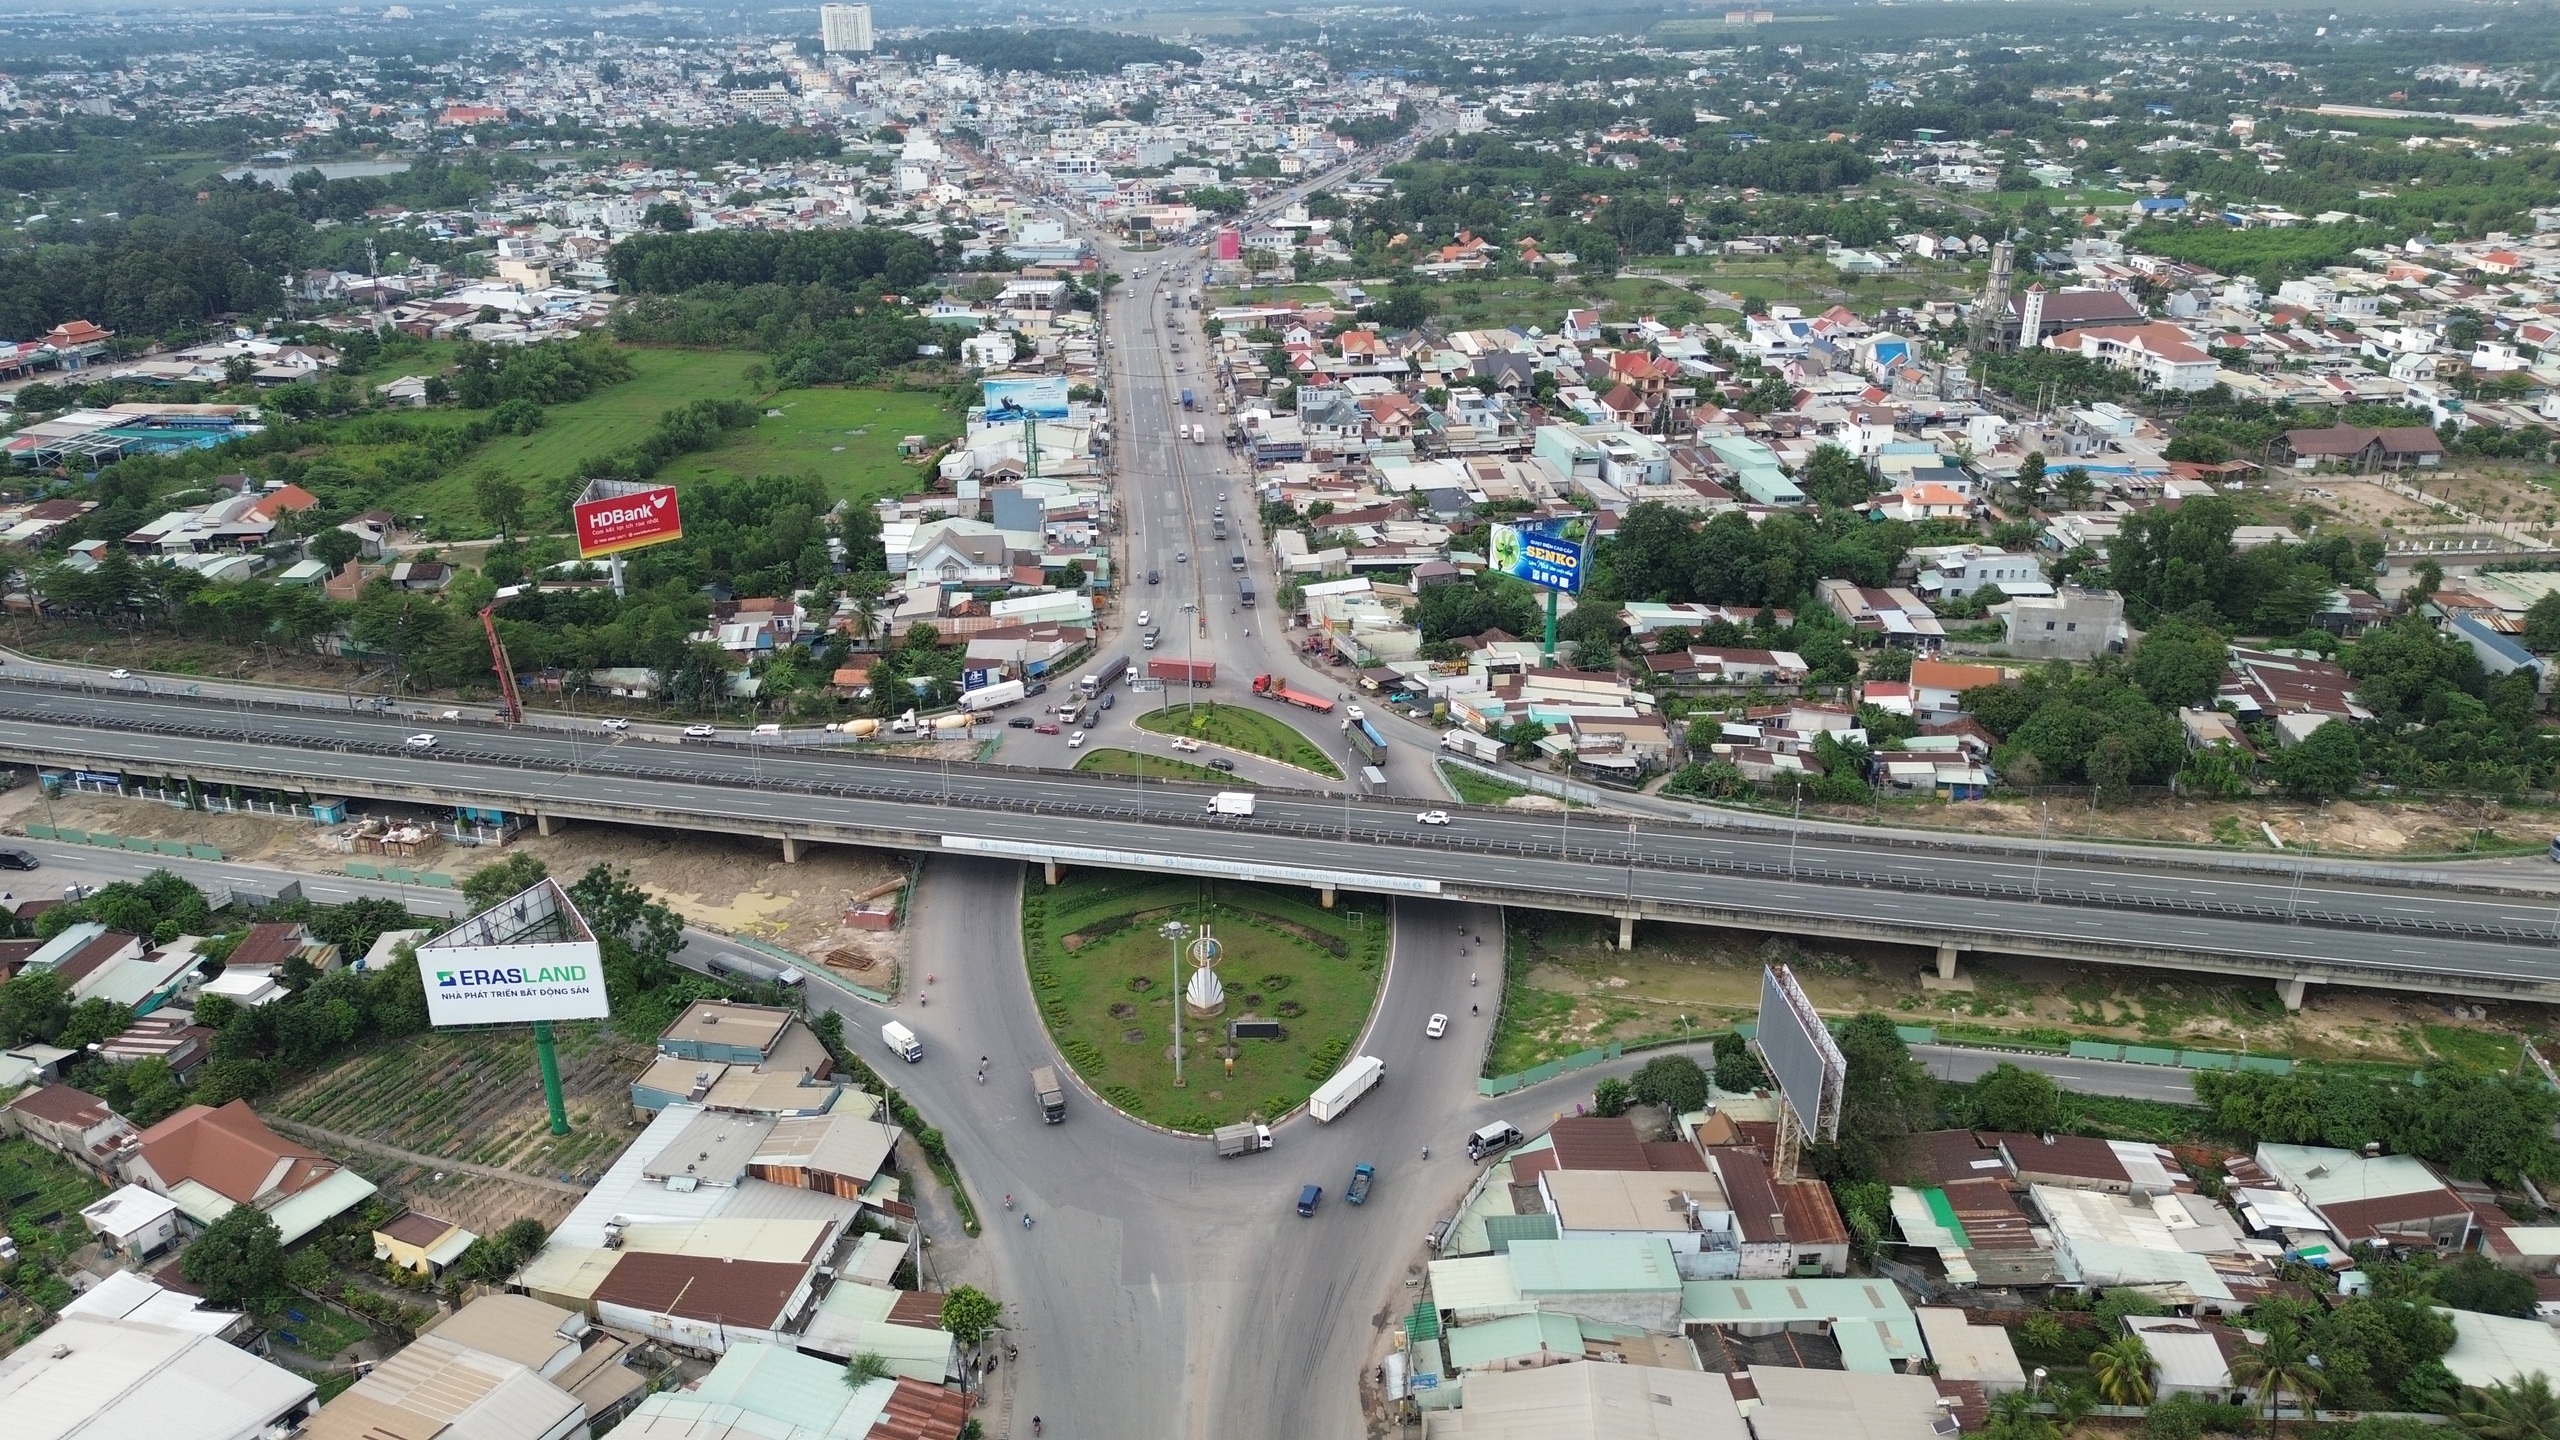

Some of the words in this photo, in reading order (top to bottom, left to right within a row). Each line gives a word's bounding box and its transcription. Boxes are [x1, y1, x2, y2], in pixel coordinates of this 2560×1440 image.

[590, 504, 653, 528] HDBank
[1526, 545, 1577, 568] SENKO
[459, 965, 587, 986] ERASLAND
[441, 991, 462, 1000] NHÀ
[464, 989, 488, 999] PHÁT
[490, 988, 518, 998] TRIỂN
[520, 986, 538, 997] BẤT
[540, 986, 569, 998] ĐỘNG
[571, 985, 590, 995] SẢN
